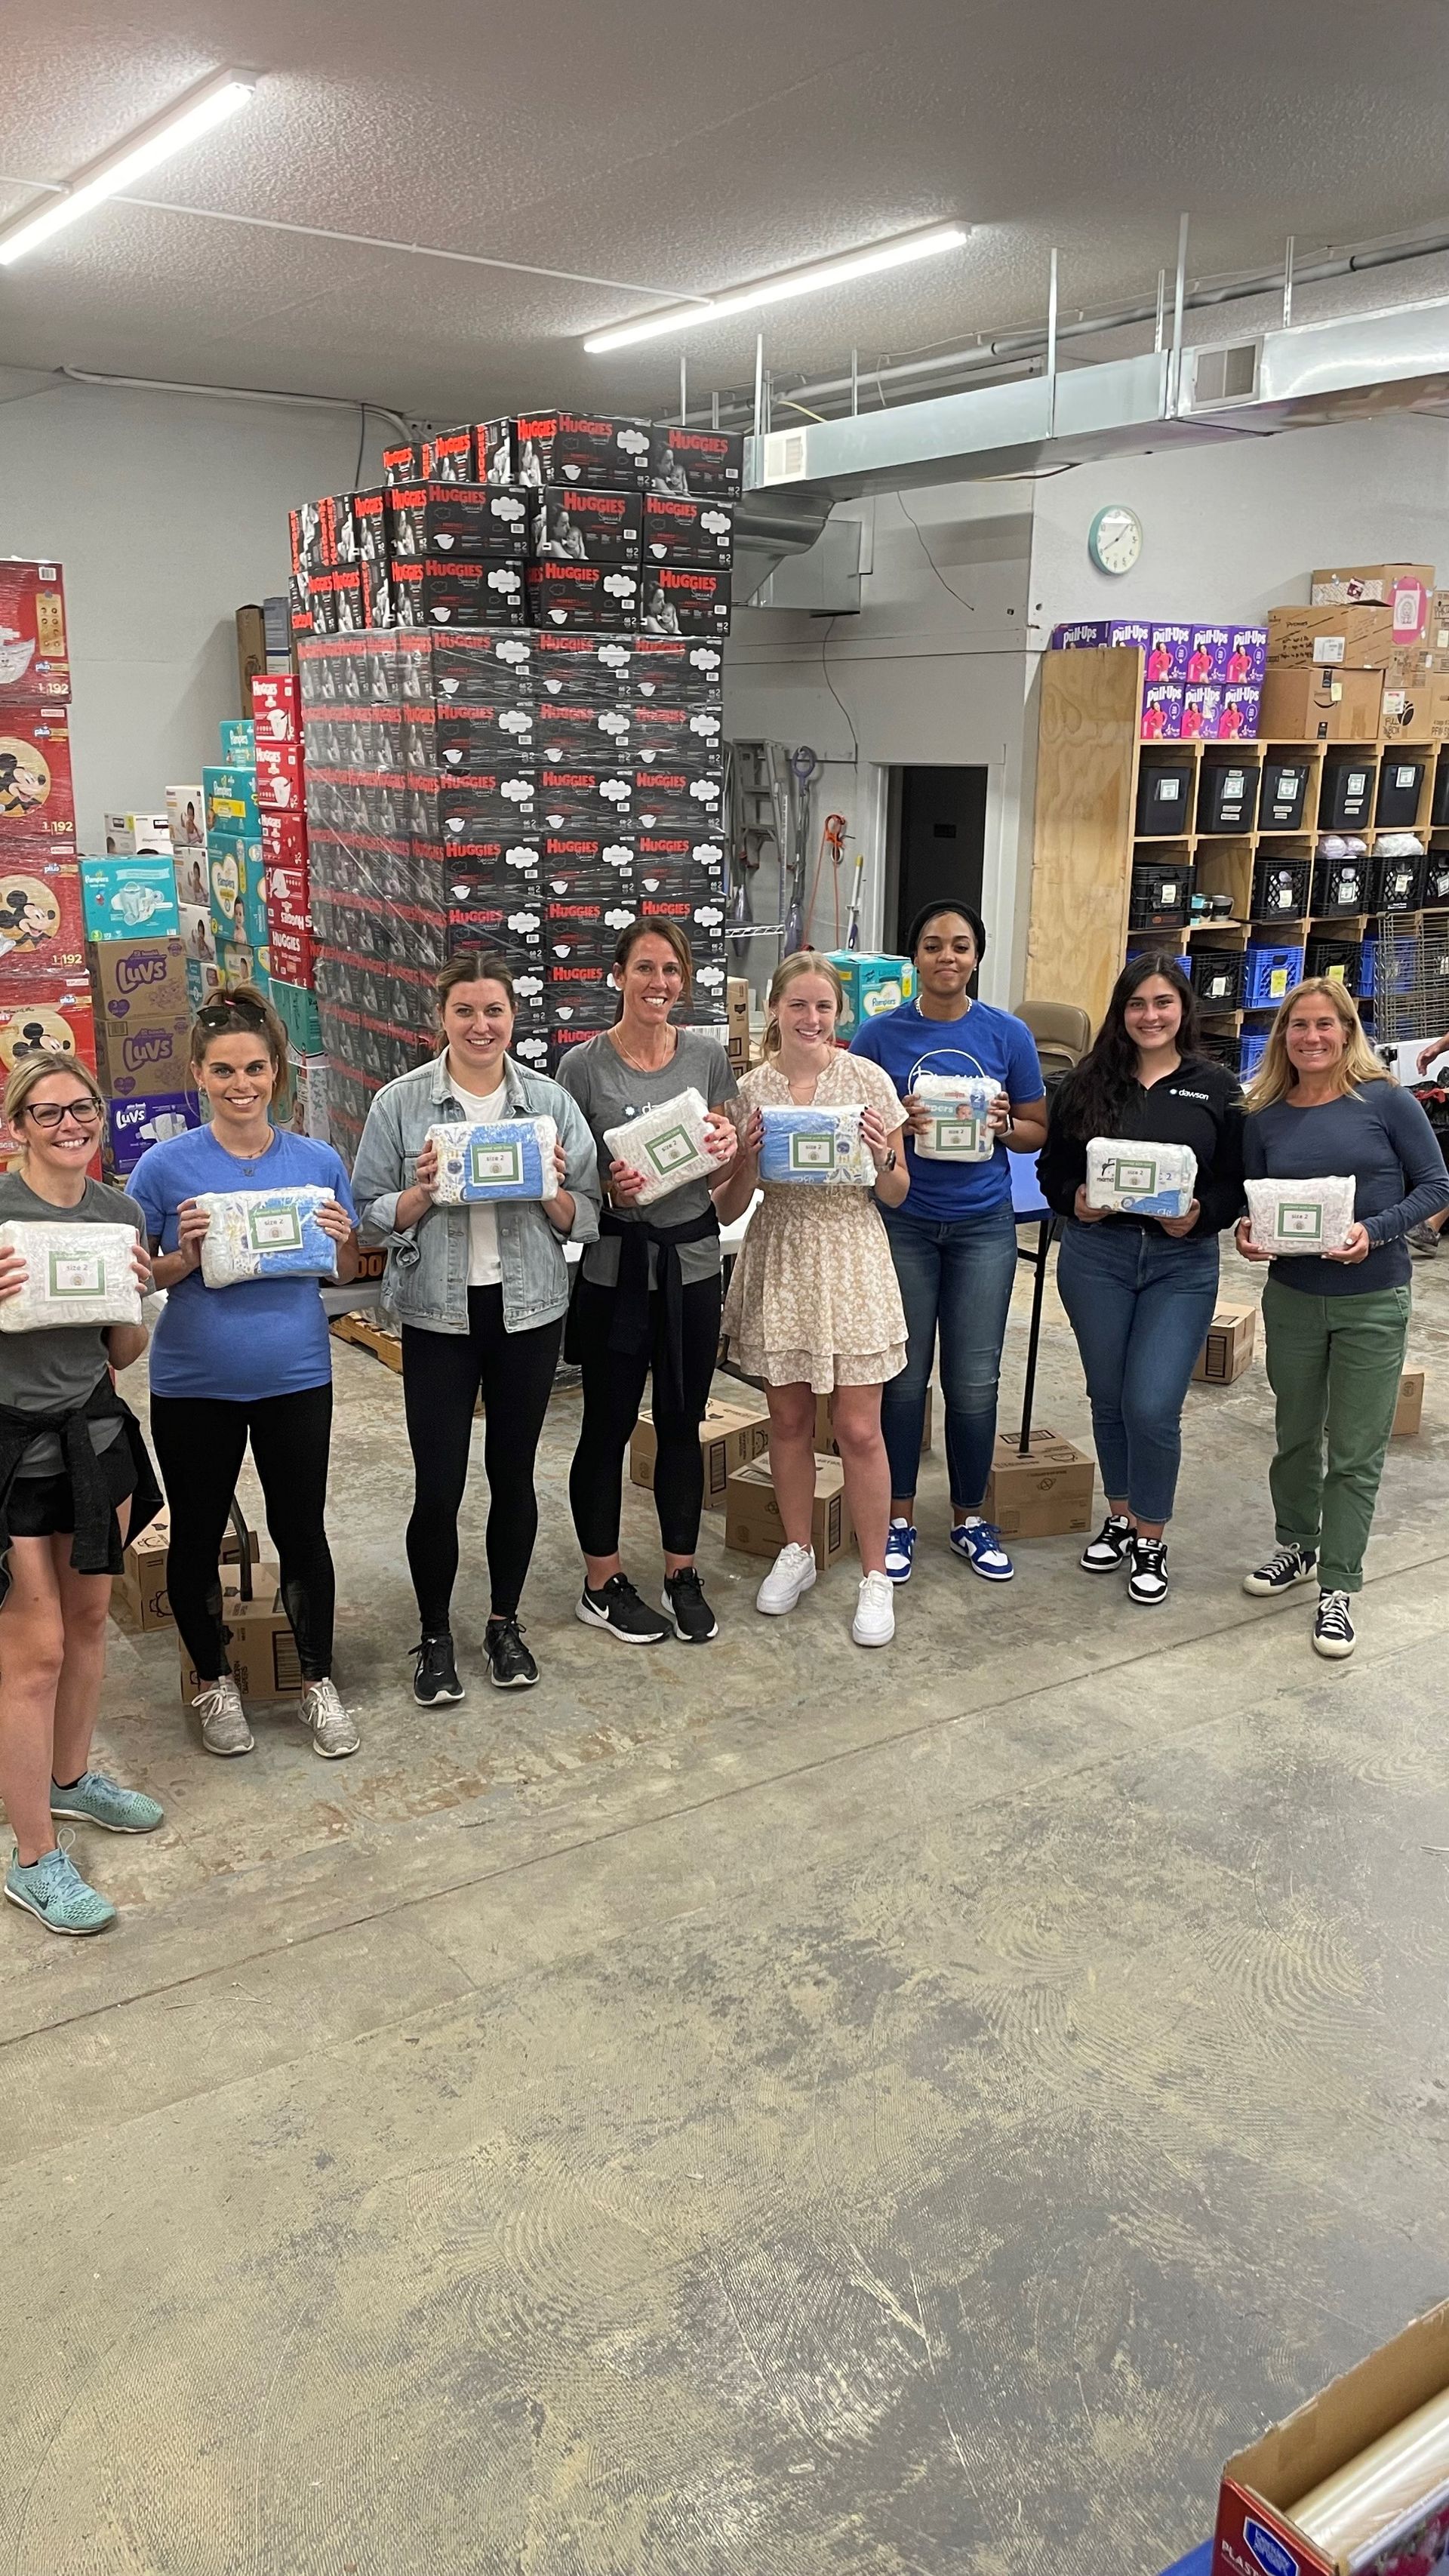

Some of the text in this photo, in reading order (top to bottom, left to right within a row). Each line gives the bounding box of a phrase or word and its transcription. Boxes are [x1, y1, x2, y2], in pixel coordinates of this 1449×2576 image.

[518, 419, 557, 441] HUGGIES
[559, 415, 613, 435] HUGGIES
[669, 429, 728, 453] HUGGIES
[392, 489, 427, 510] HUGGIES
[429, 485, 486, 504] HUGGIES
[564, 491, 626, 514] HUGGIES
[647, 497, 697, 517] HUGGIES
[392, 562, 423, 582] HUGGIES
[426, 560, 483, 577] HUGGIES
[546, 563, 600, 581] HUGGIES
[660, 570, 717, 591] HUGGIES
[1112, 626, 1149, 647] Pull-Ups
[1152, 627, 1189, 650] Pull-Ups
[1193, 630, 1228, 651] Pull-Ups
[1233, 630, 1266, 651] Pull-Ups
[48, 683, 69, 694] 192
[1146, 686, 1182, 708] Pull-Ups
[1224, 688, 1260, 708] Pull-Ups
[441, 774, 496, 789] HUGGIES
[543, 771, 595, 786] HUGGIES
[636, 772, 686, 787] HUGGIES
[52, 821, 73, 832] 192
[446, 842, 501, 857] HUGGIES
[547, 839, 598, 854] HUGGIES
[640, 837, 689, 852] HUGGIES
[449, 909, 503, 925] HUGGIES
[549, 903, 601, 919] HUGGIES
[643, 901, 690, 916] HUGGIES
[272, 931, 300, 952] HUGGIES
[62, 954, 82, 964] 192
[553, 967, 602, 981] HUGGIES
[872, 997, 896, 1007] Pampers
[974, 1094, 980, 1103] 2
[1178, 1088, 1209, 1100] dawson
[661, 1143, 672, 1152] size
